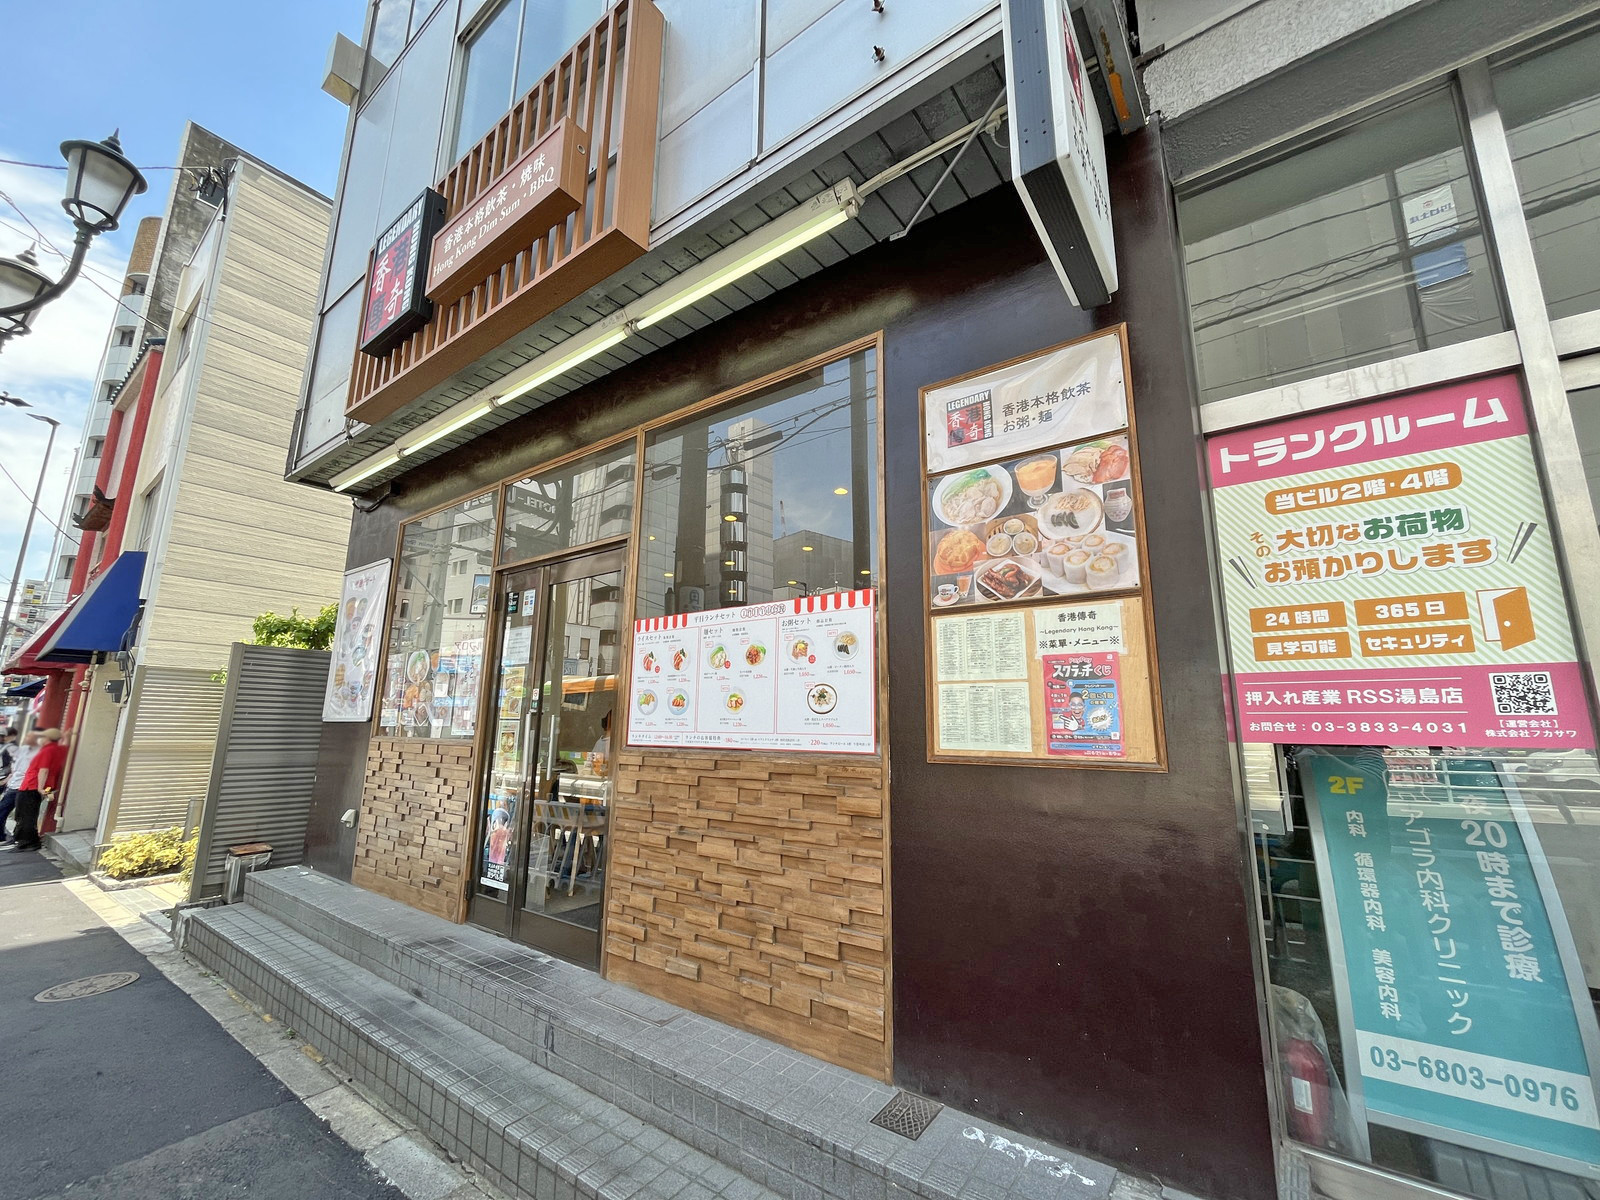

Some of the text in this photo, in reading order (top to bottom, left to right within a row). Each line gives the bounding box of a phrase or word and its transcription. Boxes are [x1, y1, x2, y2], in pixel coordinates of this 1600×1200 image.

[378, 196, 424, 256] LEGENDARY
[433, 166, 555, 278] Hong Kong Dim Sum BBQ
[402, 219, 420, 312] HONG KONG
[948, 390, 990, 411] LEGENDARY
[1002, 382, 1091, 417] 香港本格飲茶
[983, 401, 992, 438] HONG KONG
[1219, 396, 1509, 473] トランクルーム
[1274, 468, 1450, 511] 当ビル2階・4階
[1251, 531, 1271, 558] その
[1276, 508, 1465, 551] 大切なお荷物
[1264, 538, 1494, 584] お預かりします
[1058, 611, 1096, 622] 香港傳奇
[1265, 609, 1329, 626] 24 時間
[1375, 600, 1446, 619] 365 日
[1266, 639, 1337, 655] 見学可能
[1365, 633, 1466, 651] セキュリティ
[1052, 664, 1112, 678] スクラッチくじ
[1245, 687, 1463, 706] 押入れ産業 RSS湯島店
[1311, 721, 1468, 734] 03-3833-4031
[1485, 728, 1577, 739] 株式会社フカサワ
[1328, 776, 1365, 795] 2F
[1458, 794, 1543, 984] 夜20時まで診療
[1345, 810, 1402, 1022] 内科 循環器内科 美容内科
[1400, 809, 1473, 1036] アゴラ内科クリニック
[1370, 1044, 1580, 1111] 03-6803-0976
